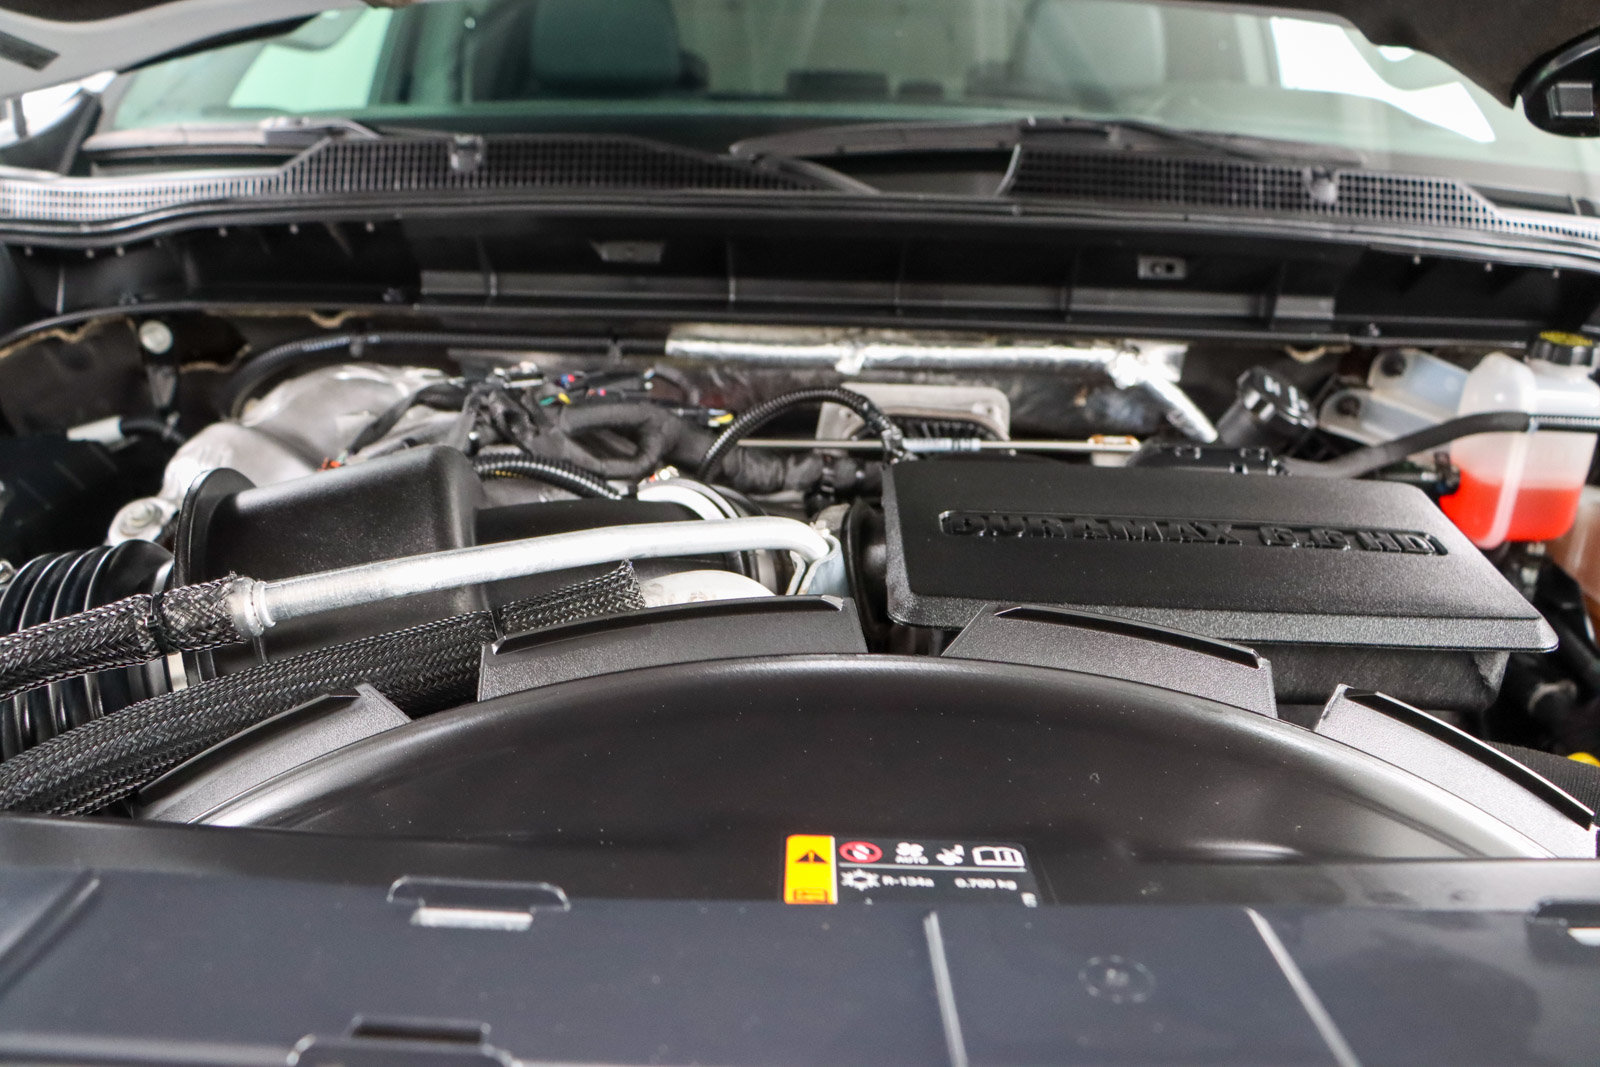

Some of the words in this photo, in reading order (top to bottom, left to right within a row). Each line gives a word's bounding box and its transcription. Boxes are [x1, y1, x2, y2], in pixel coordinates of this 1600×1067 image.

[944, 513, 1243, 544] DURAMAX
[1357, 529, 1435, 555] HD
[895, 854, 928, 864] AUTO
